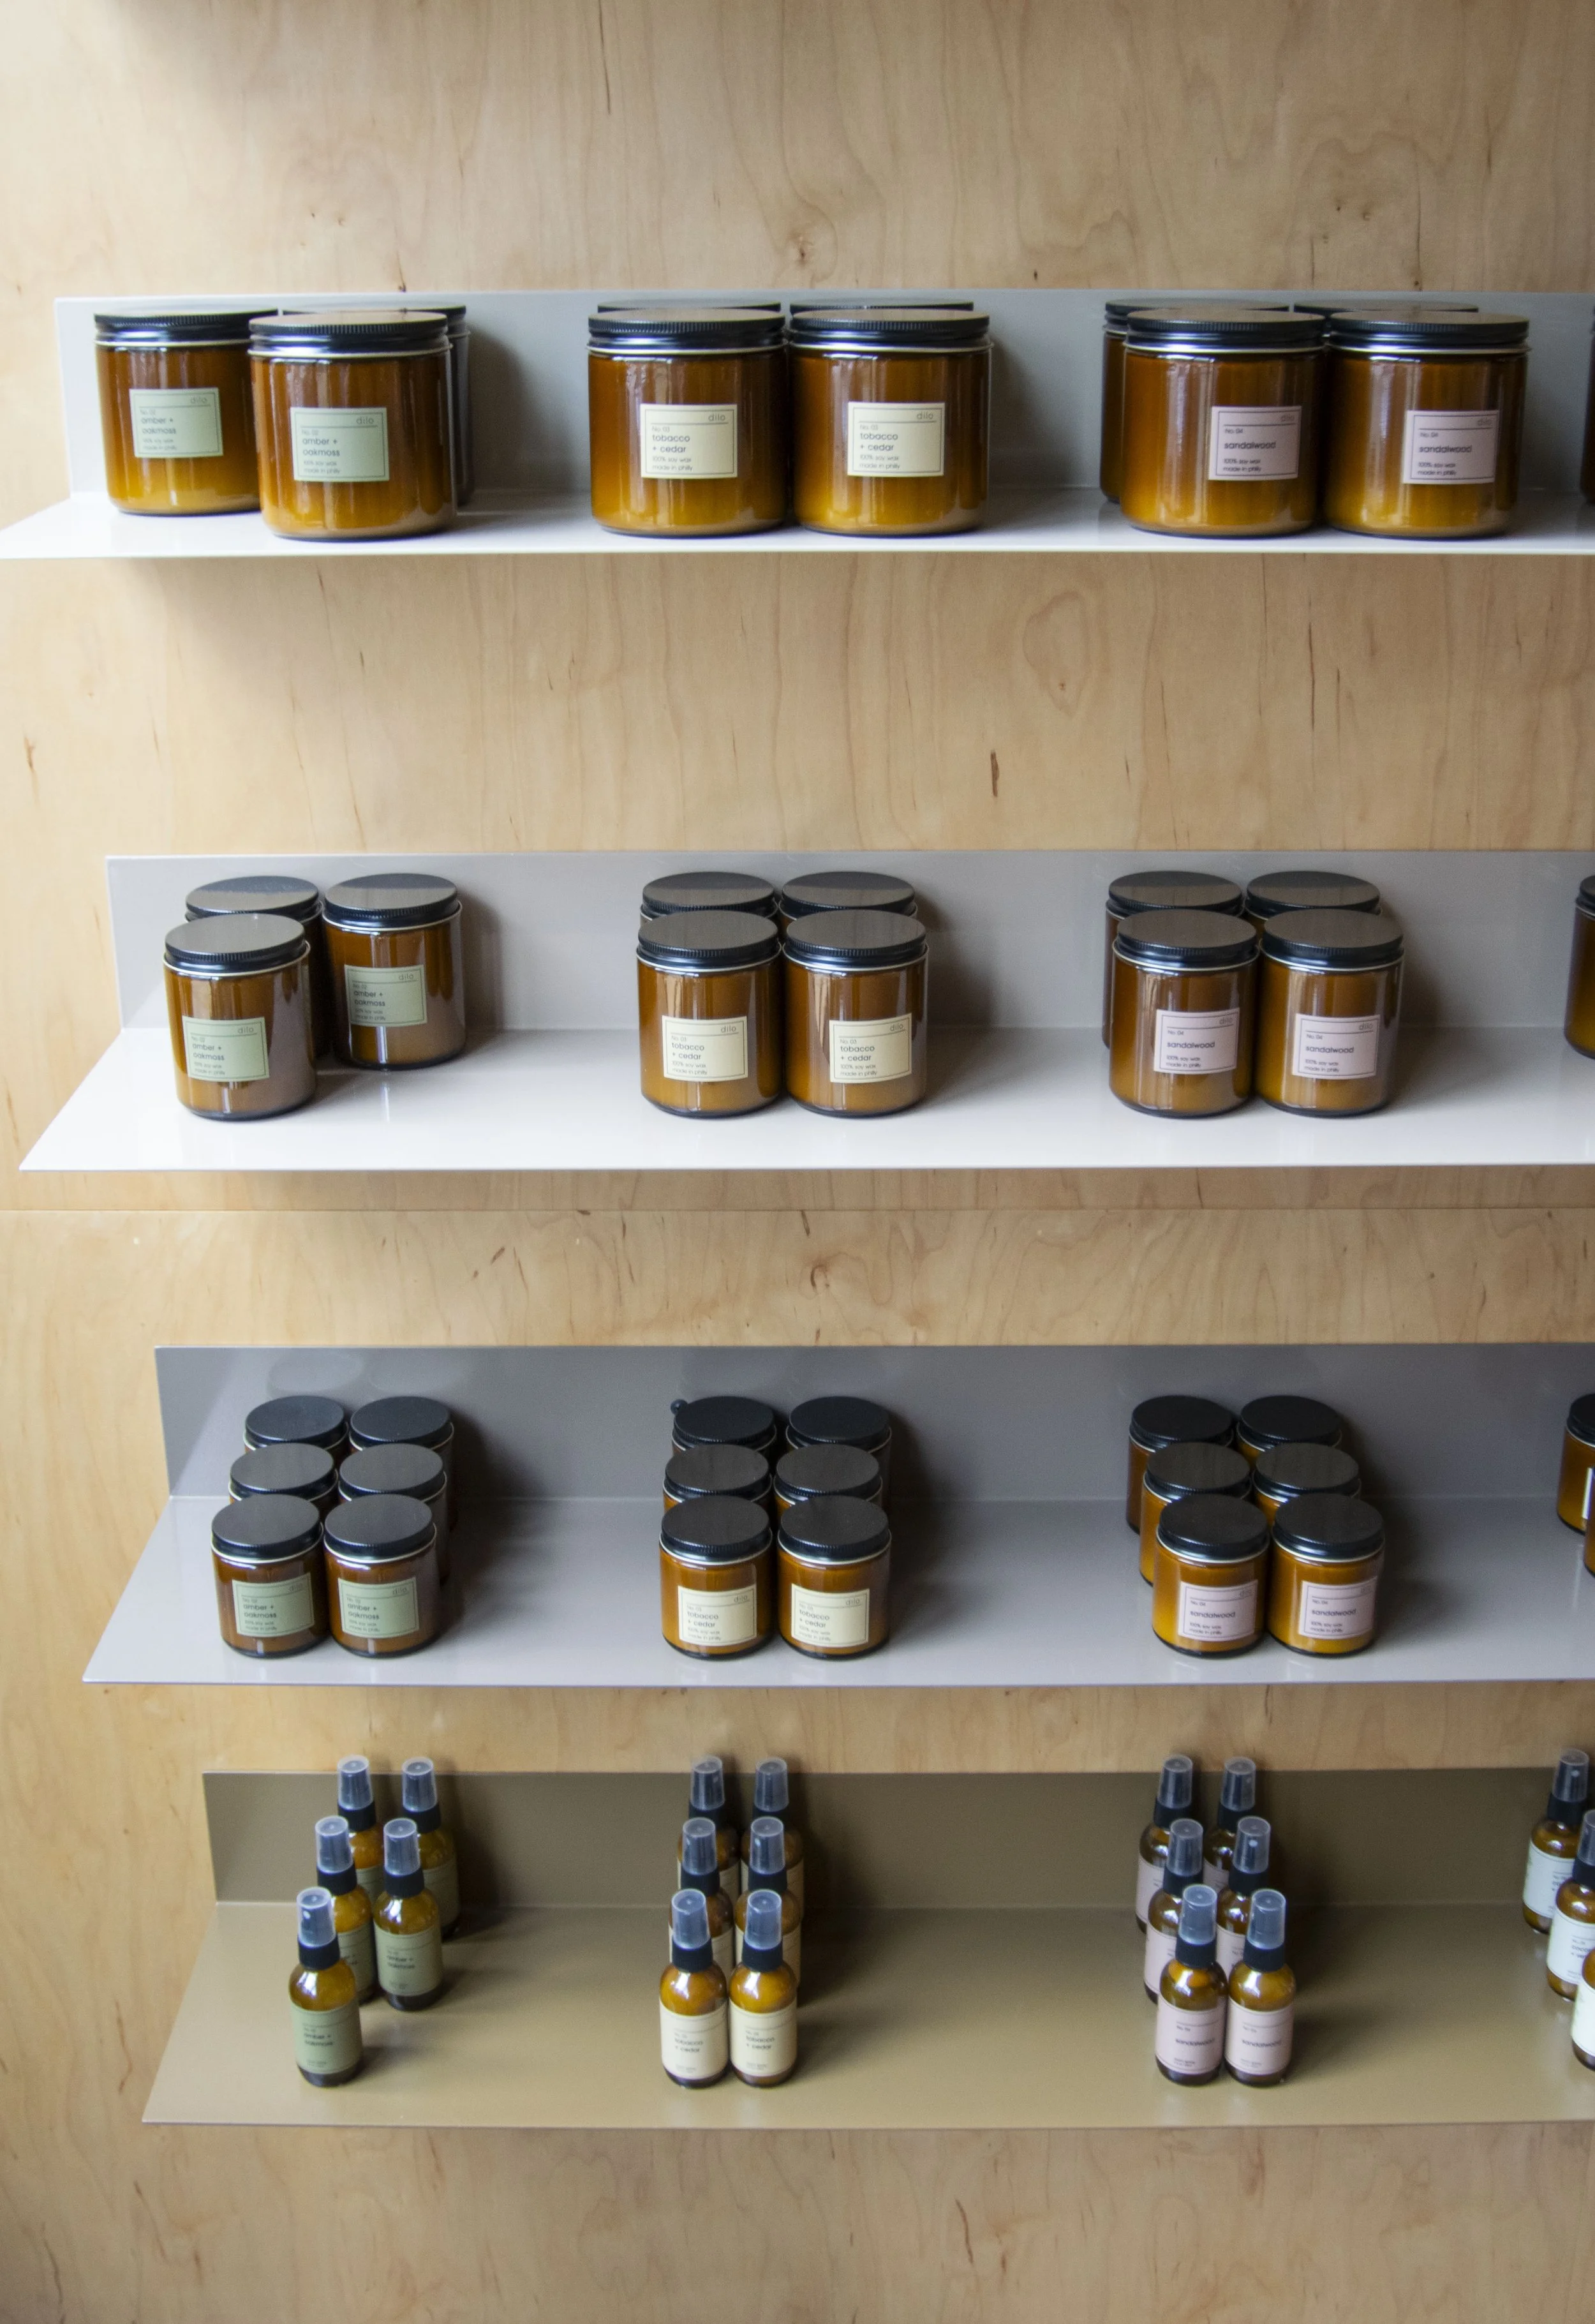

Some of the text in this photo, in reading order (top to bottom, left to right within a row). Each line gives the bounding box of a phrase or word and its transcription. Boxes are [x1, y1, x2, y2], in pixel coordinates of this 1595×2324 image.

[708, 413, 726, 421] dilo
[917, 412, 934, 420] dilo
[1224, 441, 1277, 449] sandalwood
[1419, 445, 1473, 453] sandalwood
[302, 449, 340, 457] oakmoss
[678, 464, 693, 472] philly
[399, 972, 415, 981] dilo
[721, 1025, 737, 1033] dilo
[889, 1023, 904, 1032] dilo
[192, 1043, 215, 1052] amber
[672, 1042, 705, 1051] tobacco
[193, 1052, 225, 1061] oakmoss
[678, 1052, 701, 1060] cedar
[734, 1595, 748, 1603] dilo
[347, 1603, 370, 1611] amber
[348, 1611, 380, 1620] oakmoss
[687, 1611, 719, 1620] tobacco
[799, 1609, 830, 1621] tobacco
[1190, 1611, 1236, 1619] sandalwood
[1312, 1608, 1356, 1616] sandalwood
[805, 1620, 826, 1628] cedar
